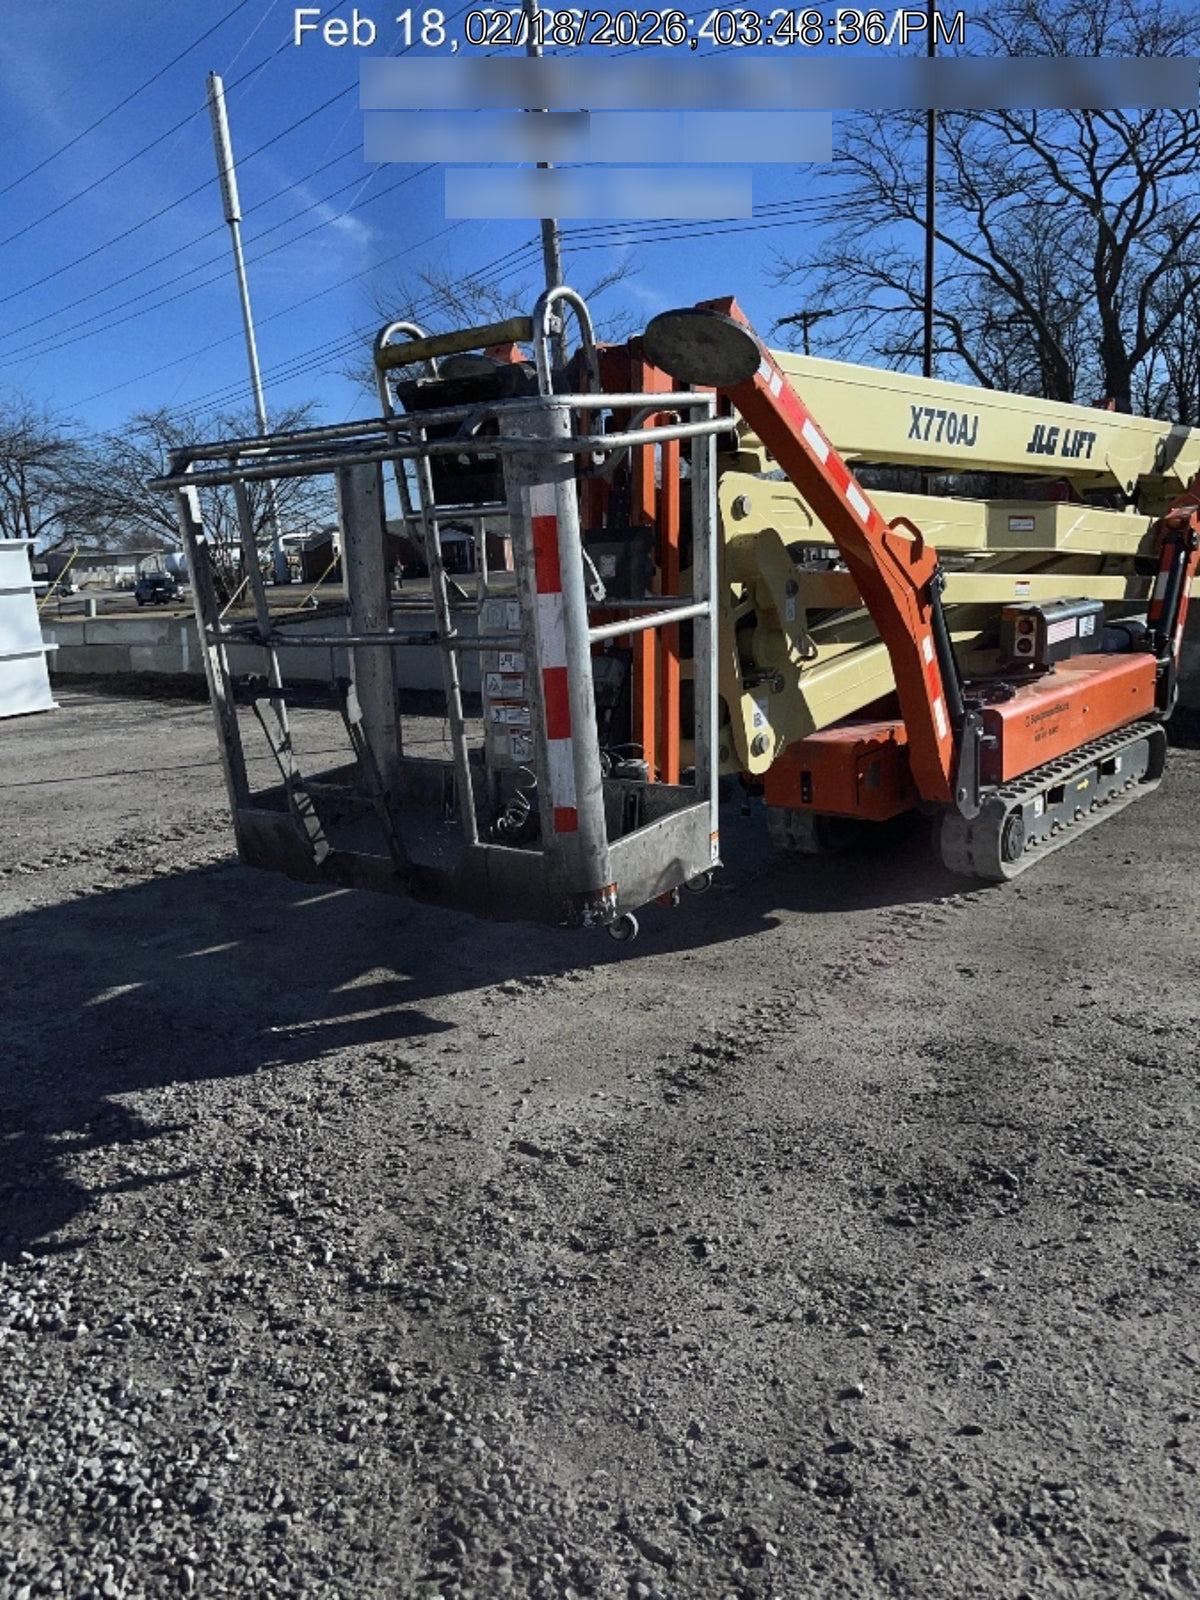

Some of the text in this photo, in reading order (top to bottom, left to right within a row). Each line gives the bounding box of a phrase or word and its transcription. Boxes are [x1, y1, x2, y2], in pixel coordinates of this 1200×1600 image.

[908, 405, 979, 447] X770AJ
[1026, 424, 1097, 459] JLG LIFT
